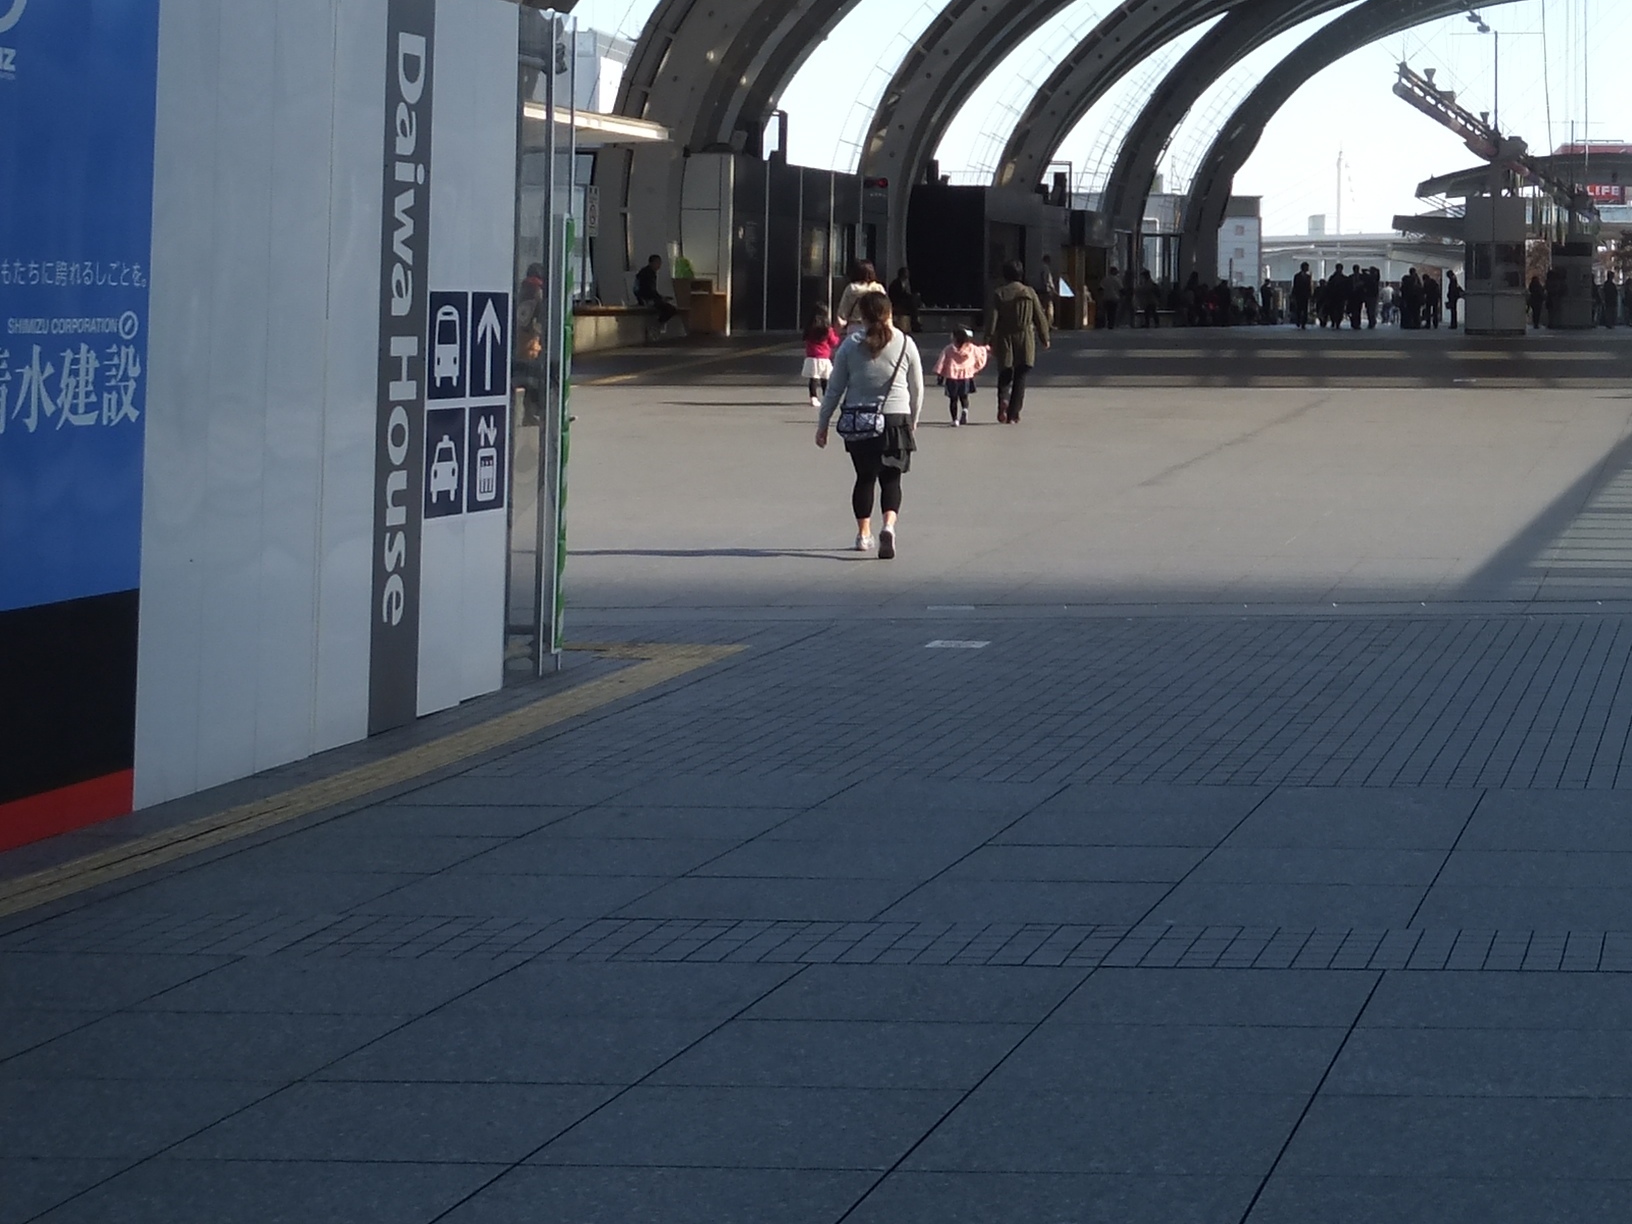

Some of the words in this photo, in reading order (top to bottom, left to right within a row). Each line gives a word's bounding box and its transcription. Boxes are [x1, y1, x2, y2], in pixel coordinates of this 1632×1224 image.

[391, 31, 427, 317] Daiwa
[1586, 184, 1621, 196] LIFE
[7, 317, 49, 335] SHIMIZU
[51, 317, 119, 334] CORPORATION
[382, 335, 419, 626] House
